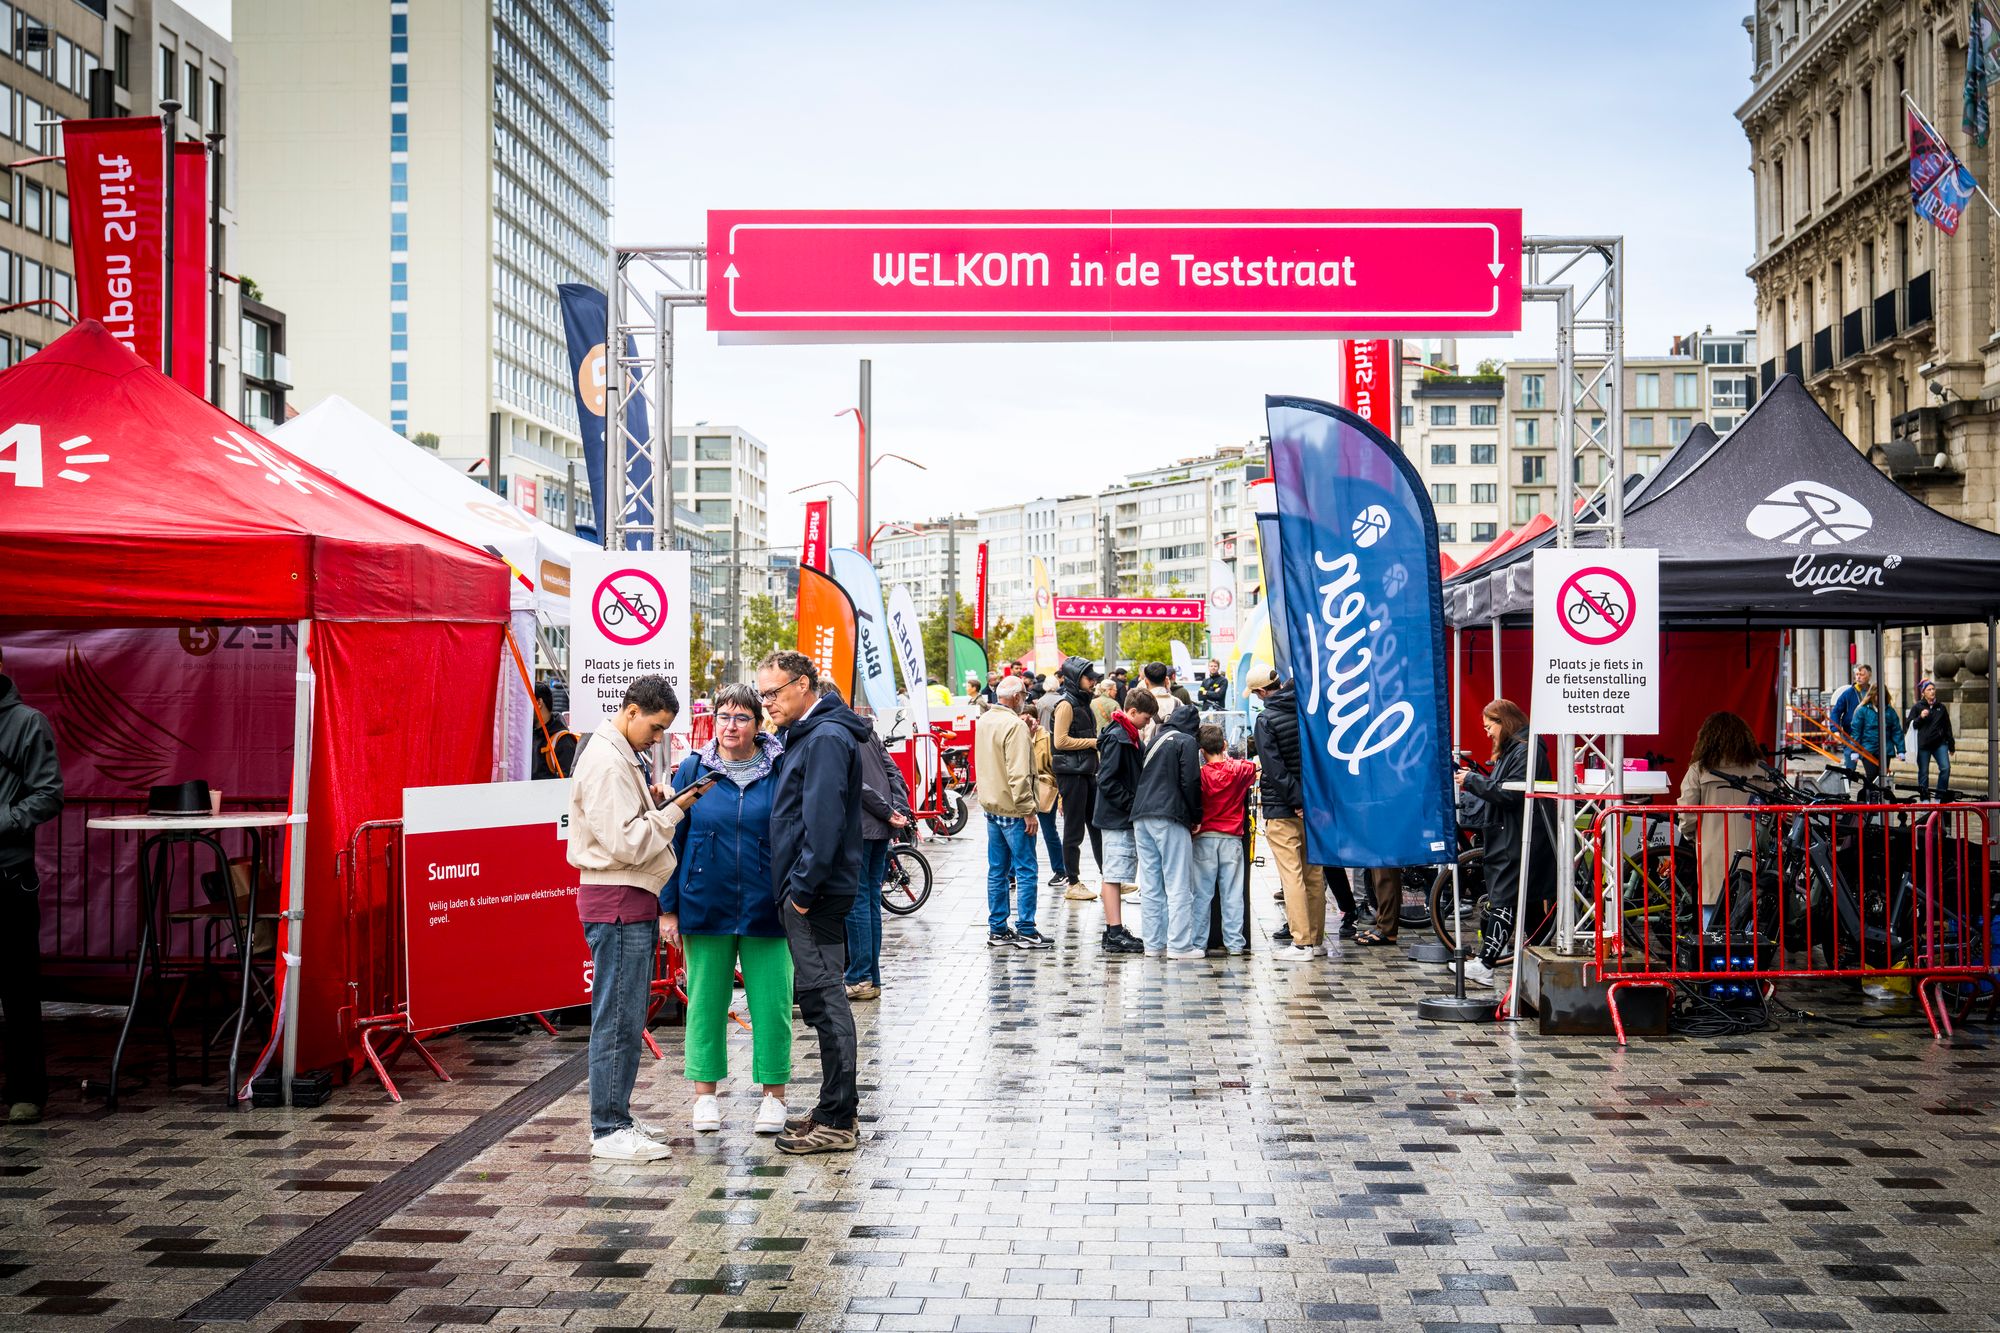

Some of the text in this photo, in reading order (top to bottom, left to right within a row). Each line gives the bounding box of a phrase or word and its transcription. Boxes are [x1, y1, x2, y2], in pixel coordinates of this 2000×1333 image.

[873, 252, 1357, 286] WELKOM in de Teststraat
[1785, 553, 1885, 588] lucien
[585, 659, 675, 671] Plaats je fiets in
[1550, 659, 1643, 671] Plaats je fiets in
[581, 674, 594, 684] de
[1546, 673, 1647, 686] de fietsenstalling
[597, 688, 626, 699] buite
[1563, 688, 1630, 699] buiten deze
[1568, 703, 1625, 714] teststraat
[428, 863, 480, 881] Sumura
[429, 901, 448, 912] Veilig
[449, 898, 468, 909] laden
[470, 897, 476, 906] &
[477, 895, 500, 906] sluiten
[501, 894, 512, 904] van
[514, 892, 530, 903] jouw
[531, 887, 565, 900] elektrische
[429, 914, 450, 927] gevel.
